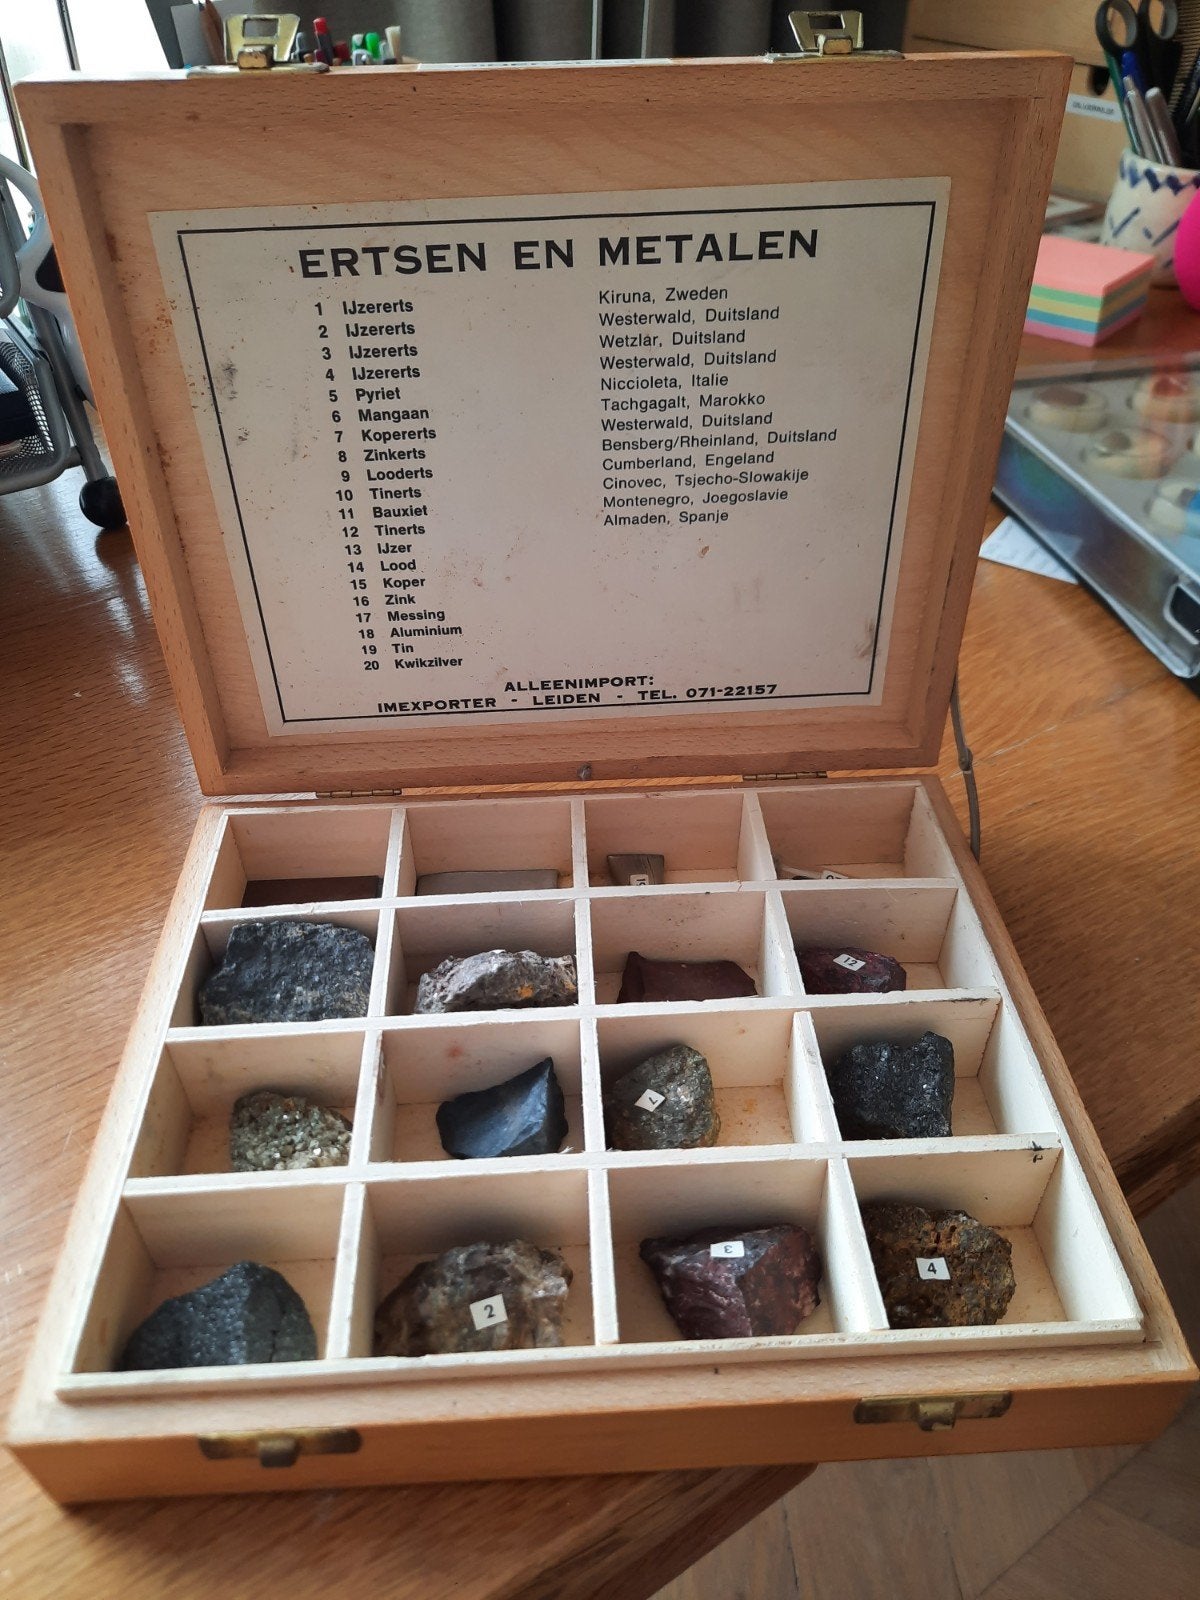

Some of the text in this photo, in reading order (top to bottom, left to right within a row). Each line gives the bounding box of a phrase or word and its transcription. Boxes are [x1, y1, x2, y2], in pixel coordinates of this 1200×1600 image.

[298, 229, 818, 279] ERTSEN EN METALEN
[599, 287, 728, 305] Kiruna, Zweden
[314, 299, 414, 316] 1 IJzererts
[598, 307, 780, 327] Westerwald, Duitsland
[318, 322, 416, 339] 2 IJzererts
[599, 330, 746, 349] Wetzlar, Duitsland
[321, 344, 419, 361] 3 IJzererts
[599, 350, 777, 370] Westerwald, Duitsland
[325, 366, 421, 382] 4 IJzererts
[601, 373, 729, 391] Niccioleta, Italie
[328, 387, 401, 404] 5 Pyriet
[600, 393, 766, 413] Tachgagalt, Marokko
[331, 409, 430, 424] 6 Mangaan
[600, 412, 773, 432] Westerwald, Duitsland
[334, 428, 437, 445] 7 Kopererts
[602, 429, 838, 452] Bensberg/Rheinland, Duitsland
[338, 448, 426, 463] 8 Zinkerts
[602, 451, 775, 471] Cumberland, Engeland
[340, 467, 434, 483] 9 Looderts
[602, 469, 809, 490] Cinovec, Tsjecho-Slowakije
[335, 487, 422, 502] 10 Tinerts
[603, 489, 789, 508] Montenegro, Joegoslavie
[338, 505, 429, 520] 11 Bauxiet
[603, 510, 729, 526] Almaden, Spanje
[342, 524, 426, 538] 12 Tinerts
[344, 543, 413, 556] 13 IJzer
[347, 559, 417, 573] 14 Lood
[349, 578, 426, 591] 15 Koper
[352, 594, 416, 607] 16 Zink
[355, 610, 446, 623] 17 Messing
[358, 625, 463, 640] 18 Aluminium
[361, 643, 414, 655] 19 Tin
[363, 657, 463, 671] 20 Kwikzilver
[504, 676, 655, 693] ALLEENIMPORT:
[377, 698, 497, 713] IMEXPORTER
[532, 693, 601, 706] LEIDEN
[637, 690, 677, 701] TEL.
[686, 684, 778, 699] 071-22157
[843, 957, 858, 967] 12
[926, 1261, 937, 1275] 4
[483, 1304, 497, 1319] 2
